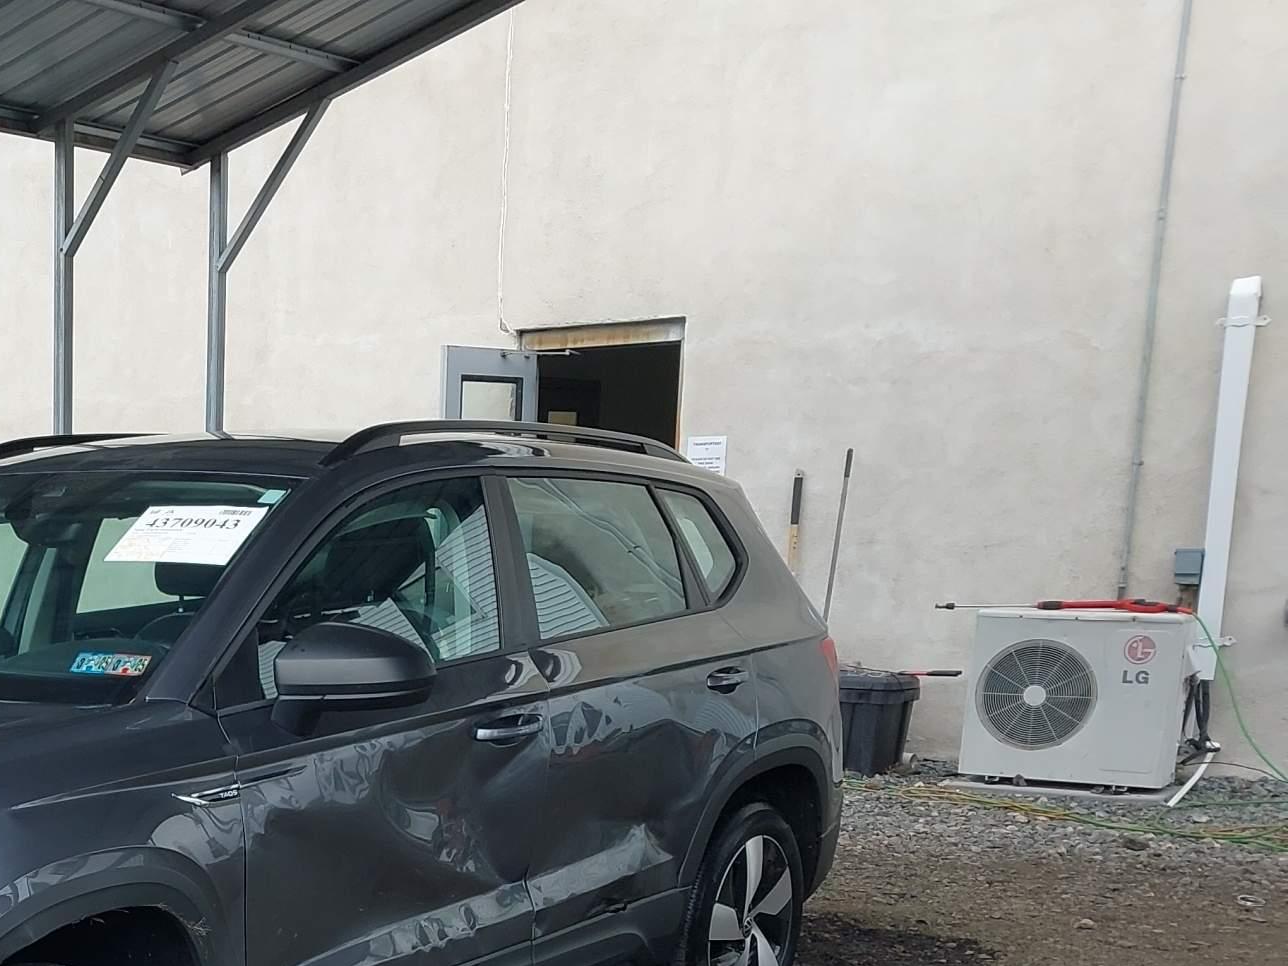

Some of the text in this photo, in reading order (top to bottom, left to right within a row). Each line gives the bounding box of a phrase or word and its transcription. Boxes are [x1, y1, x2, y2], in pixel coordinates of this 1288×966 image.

[145, 517, 241, 530] 43709043
[1121, 670, 1150, 684] LG
[219, 790, 238, 798] TAOS
